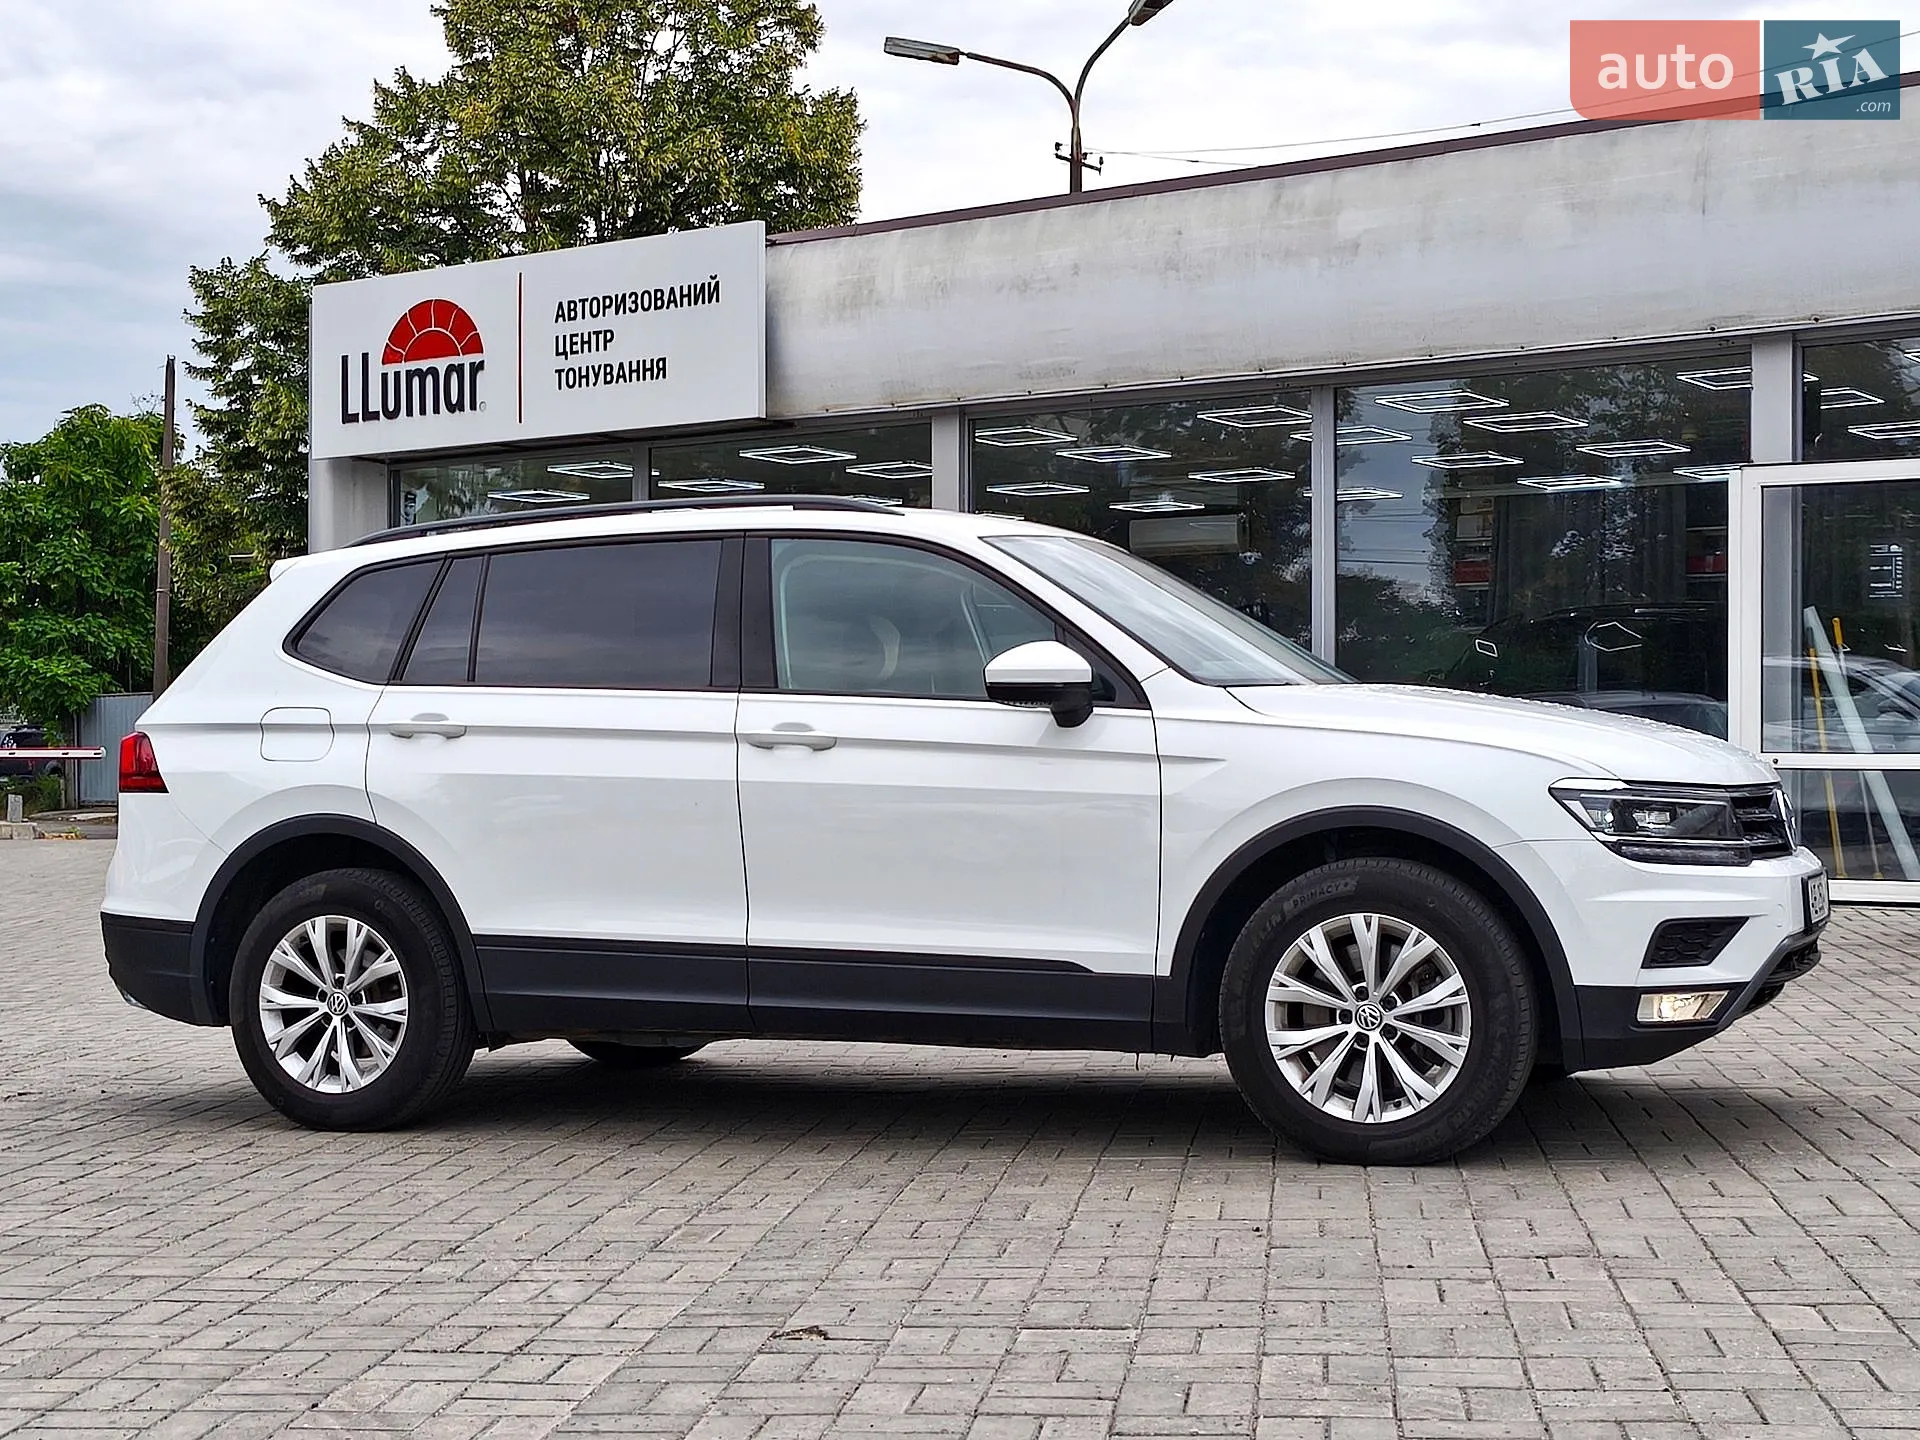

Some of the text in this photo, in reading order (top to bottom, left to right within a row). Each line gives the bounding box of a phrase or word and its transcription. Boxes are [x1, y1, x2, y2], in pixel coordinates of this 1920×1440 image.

[554, 275, 720, 323] АВТОРИЗОВАНИЙ
[554, 329, 615, 359] ЦЕНТР
[554, 357, 667, 390] ТОНУВАННЯ
